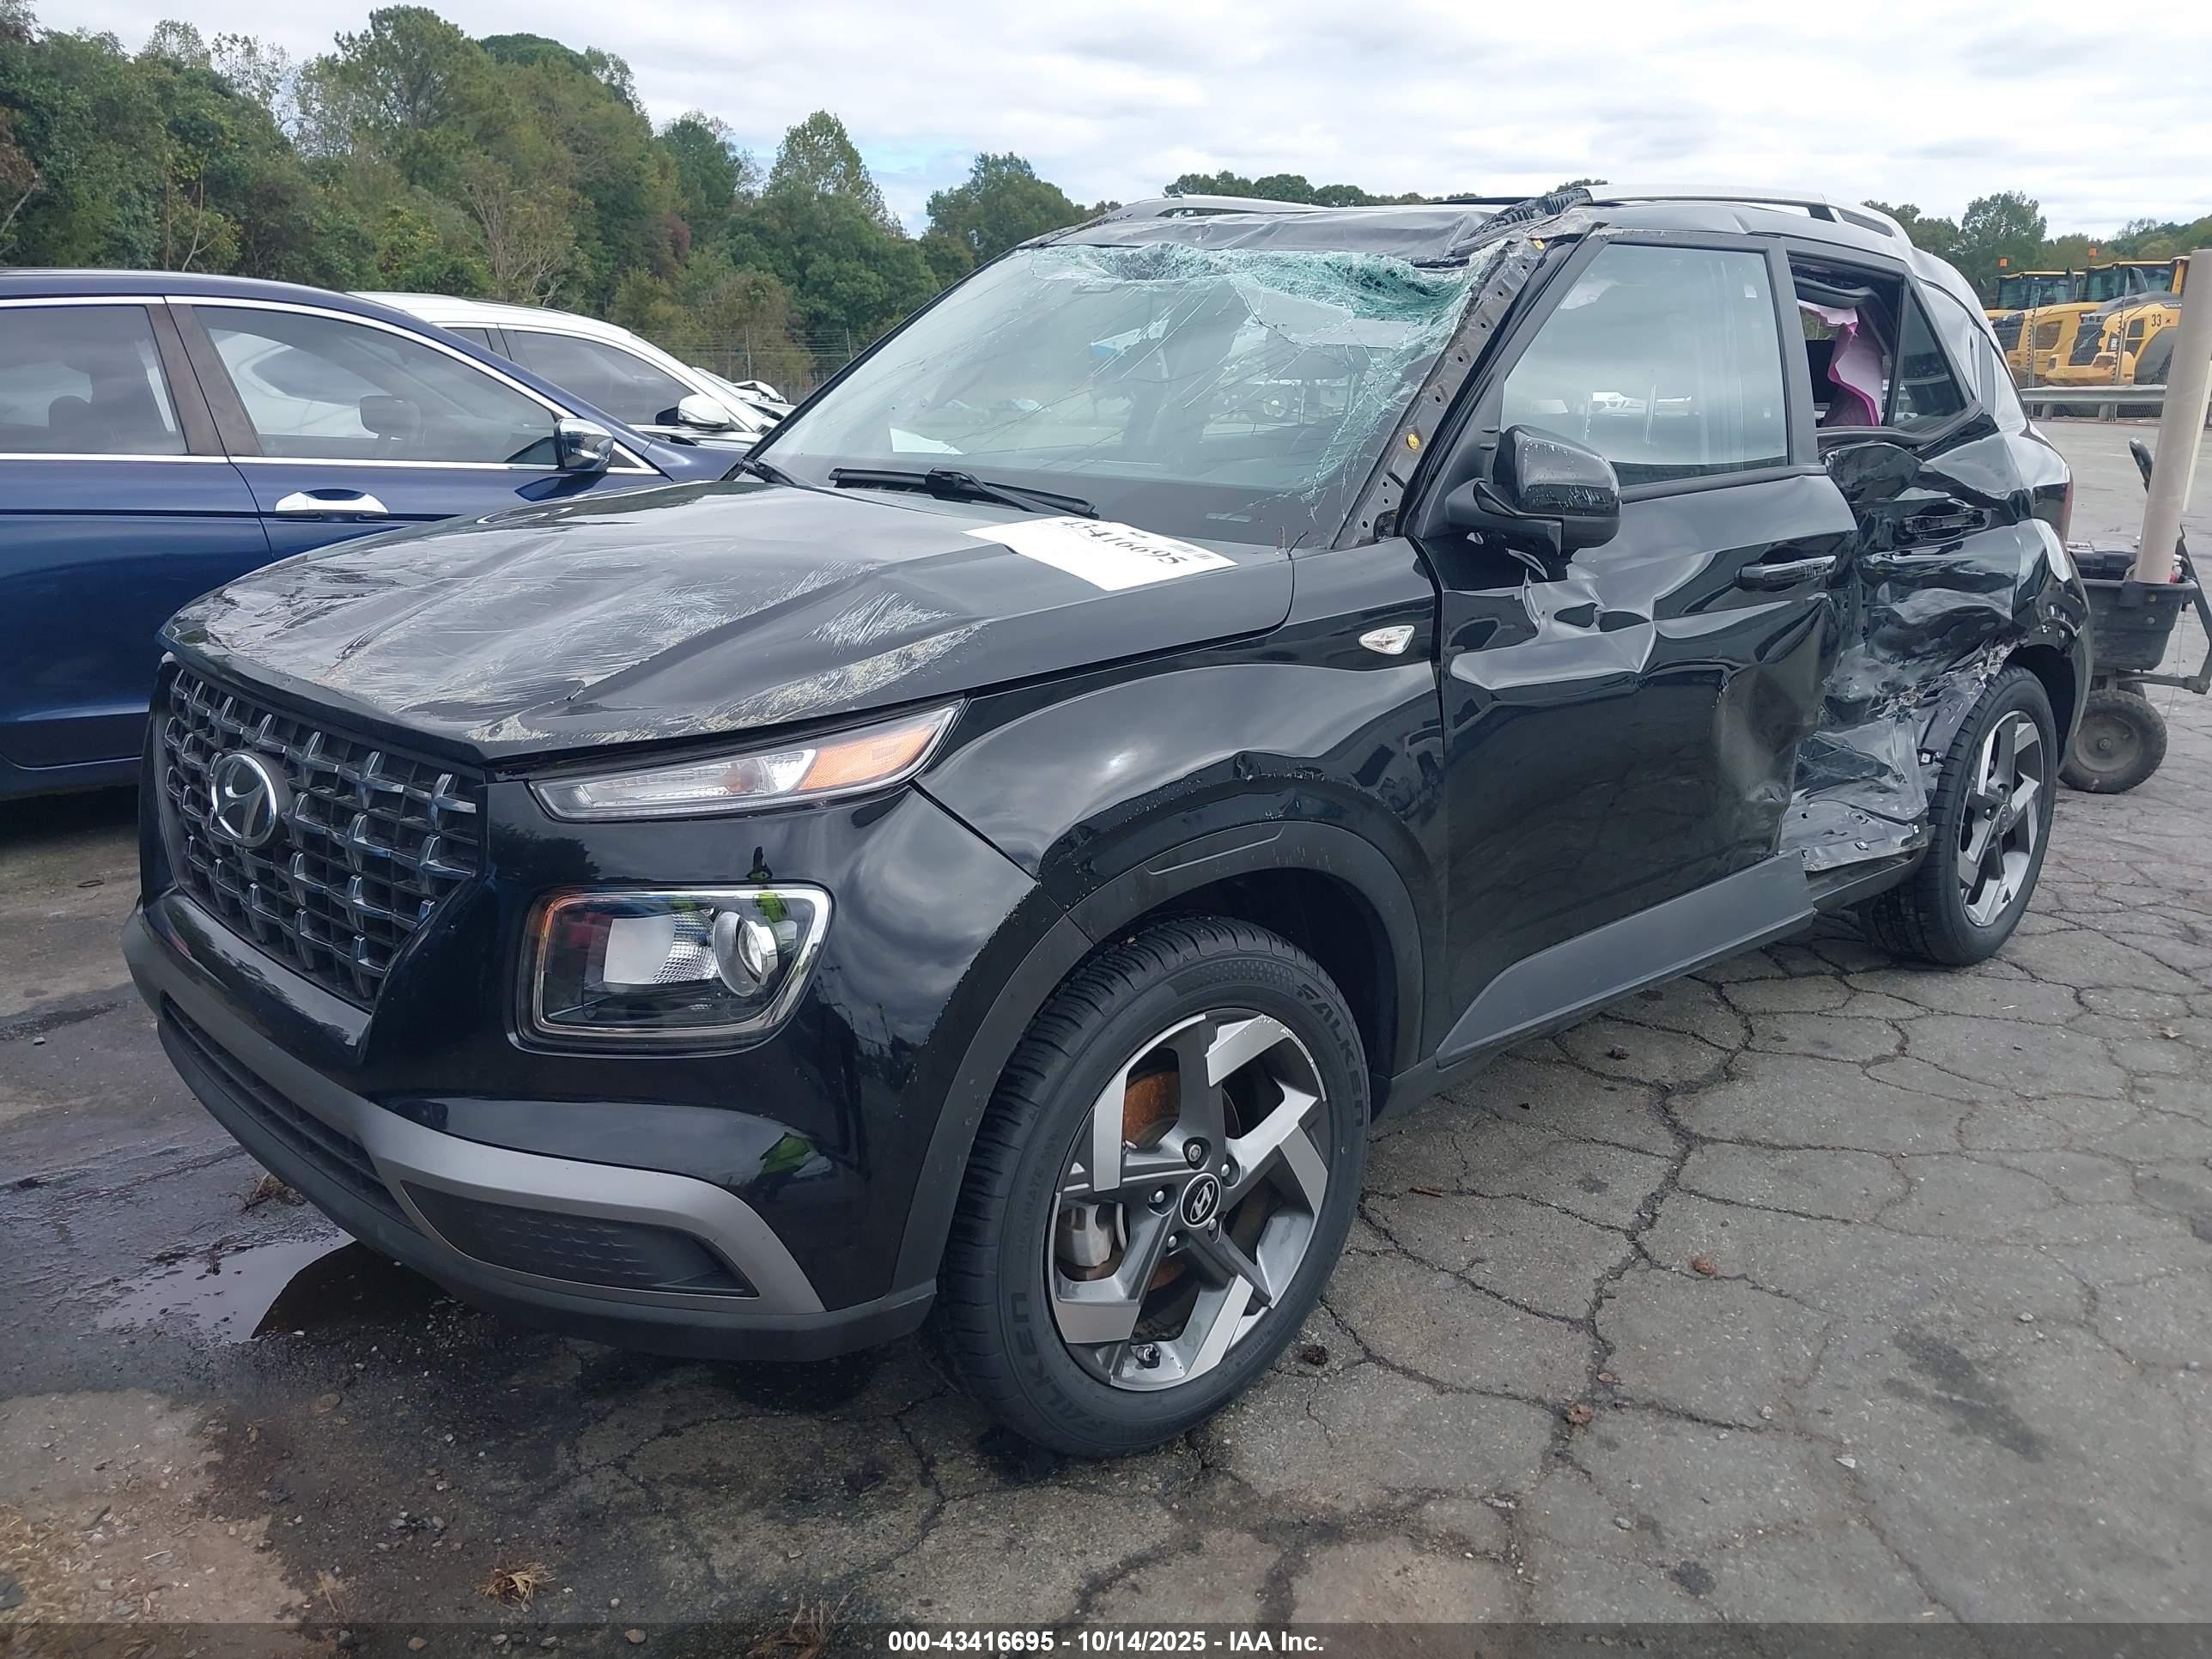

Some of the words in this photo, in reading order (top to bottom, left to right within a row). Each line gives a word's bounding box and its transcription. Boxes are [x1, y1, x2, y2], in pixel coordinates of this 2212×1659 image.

[2151, 313, 2162, 327] 33
[1060, 521, 1188, 564] 43416695
[1295, 982, 1364, 1127] FALKEN
